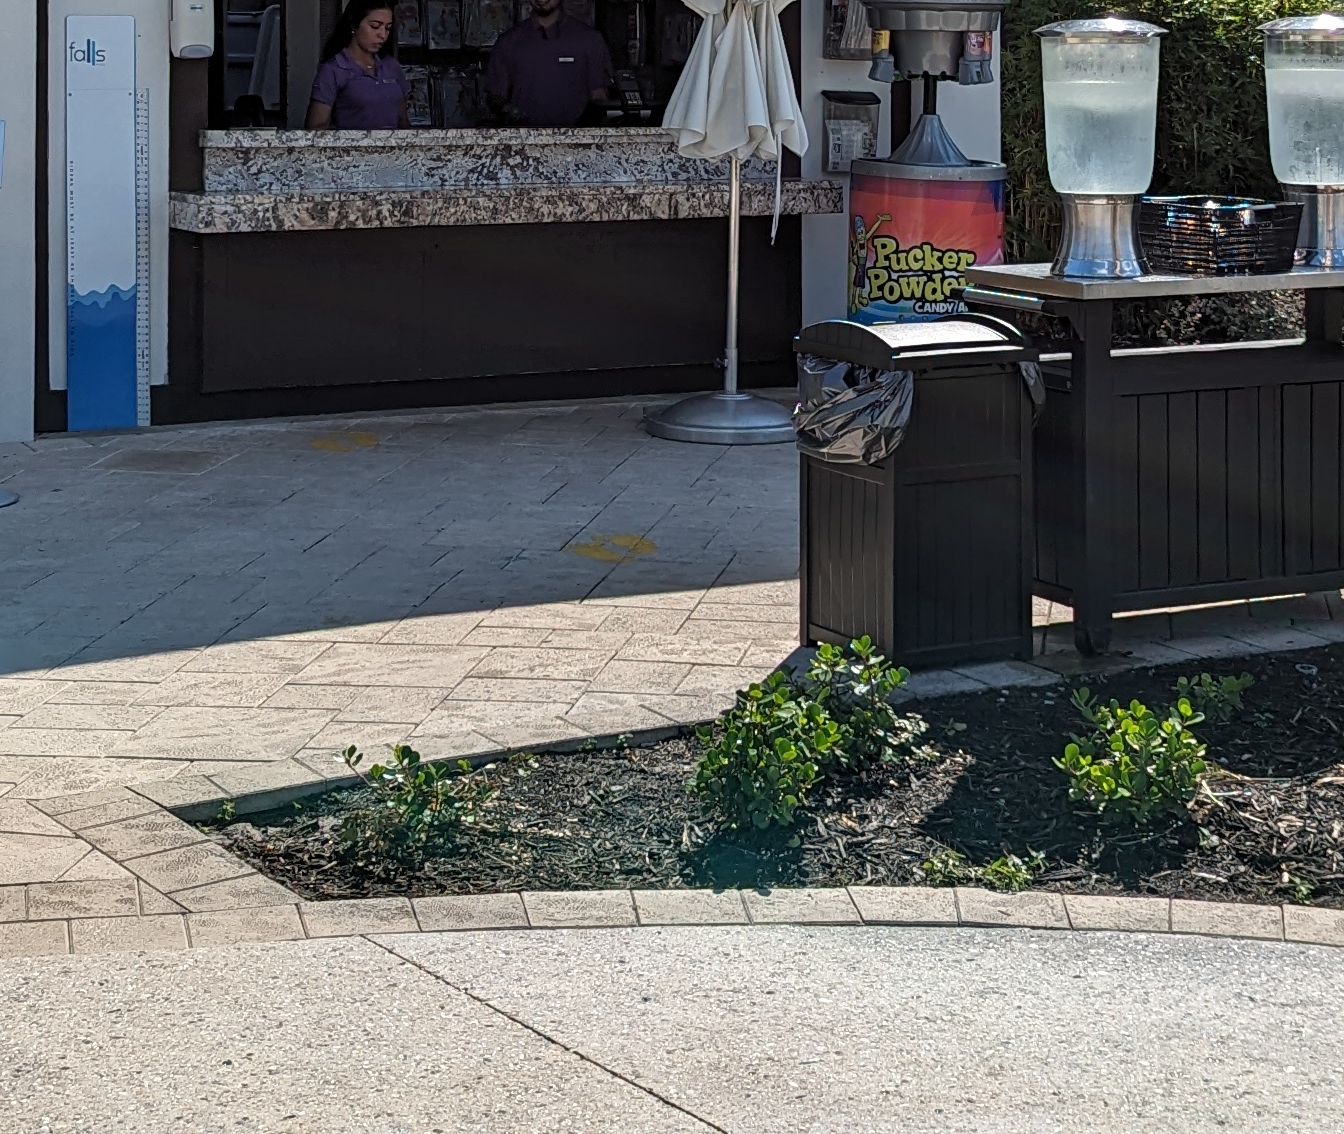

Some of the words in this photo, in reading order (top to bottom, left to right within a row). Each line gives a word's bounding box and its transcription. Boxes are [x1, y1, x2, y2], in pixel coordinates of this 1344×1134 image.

[69, 38, 106, 66] falls
[872, 236, 976, 273] Pucker
[867, 268, 969, 303] Powde
[914, 301, 957, 314] CANDY
